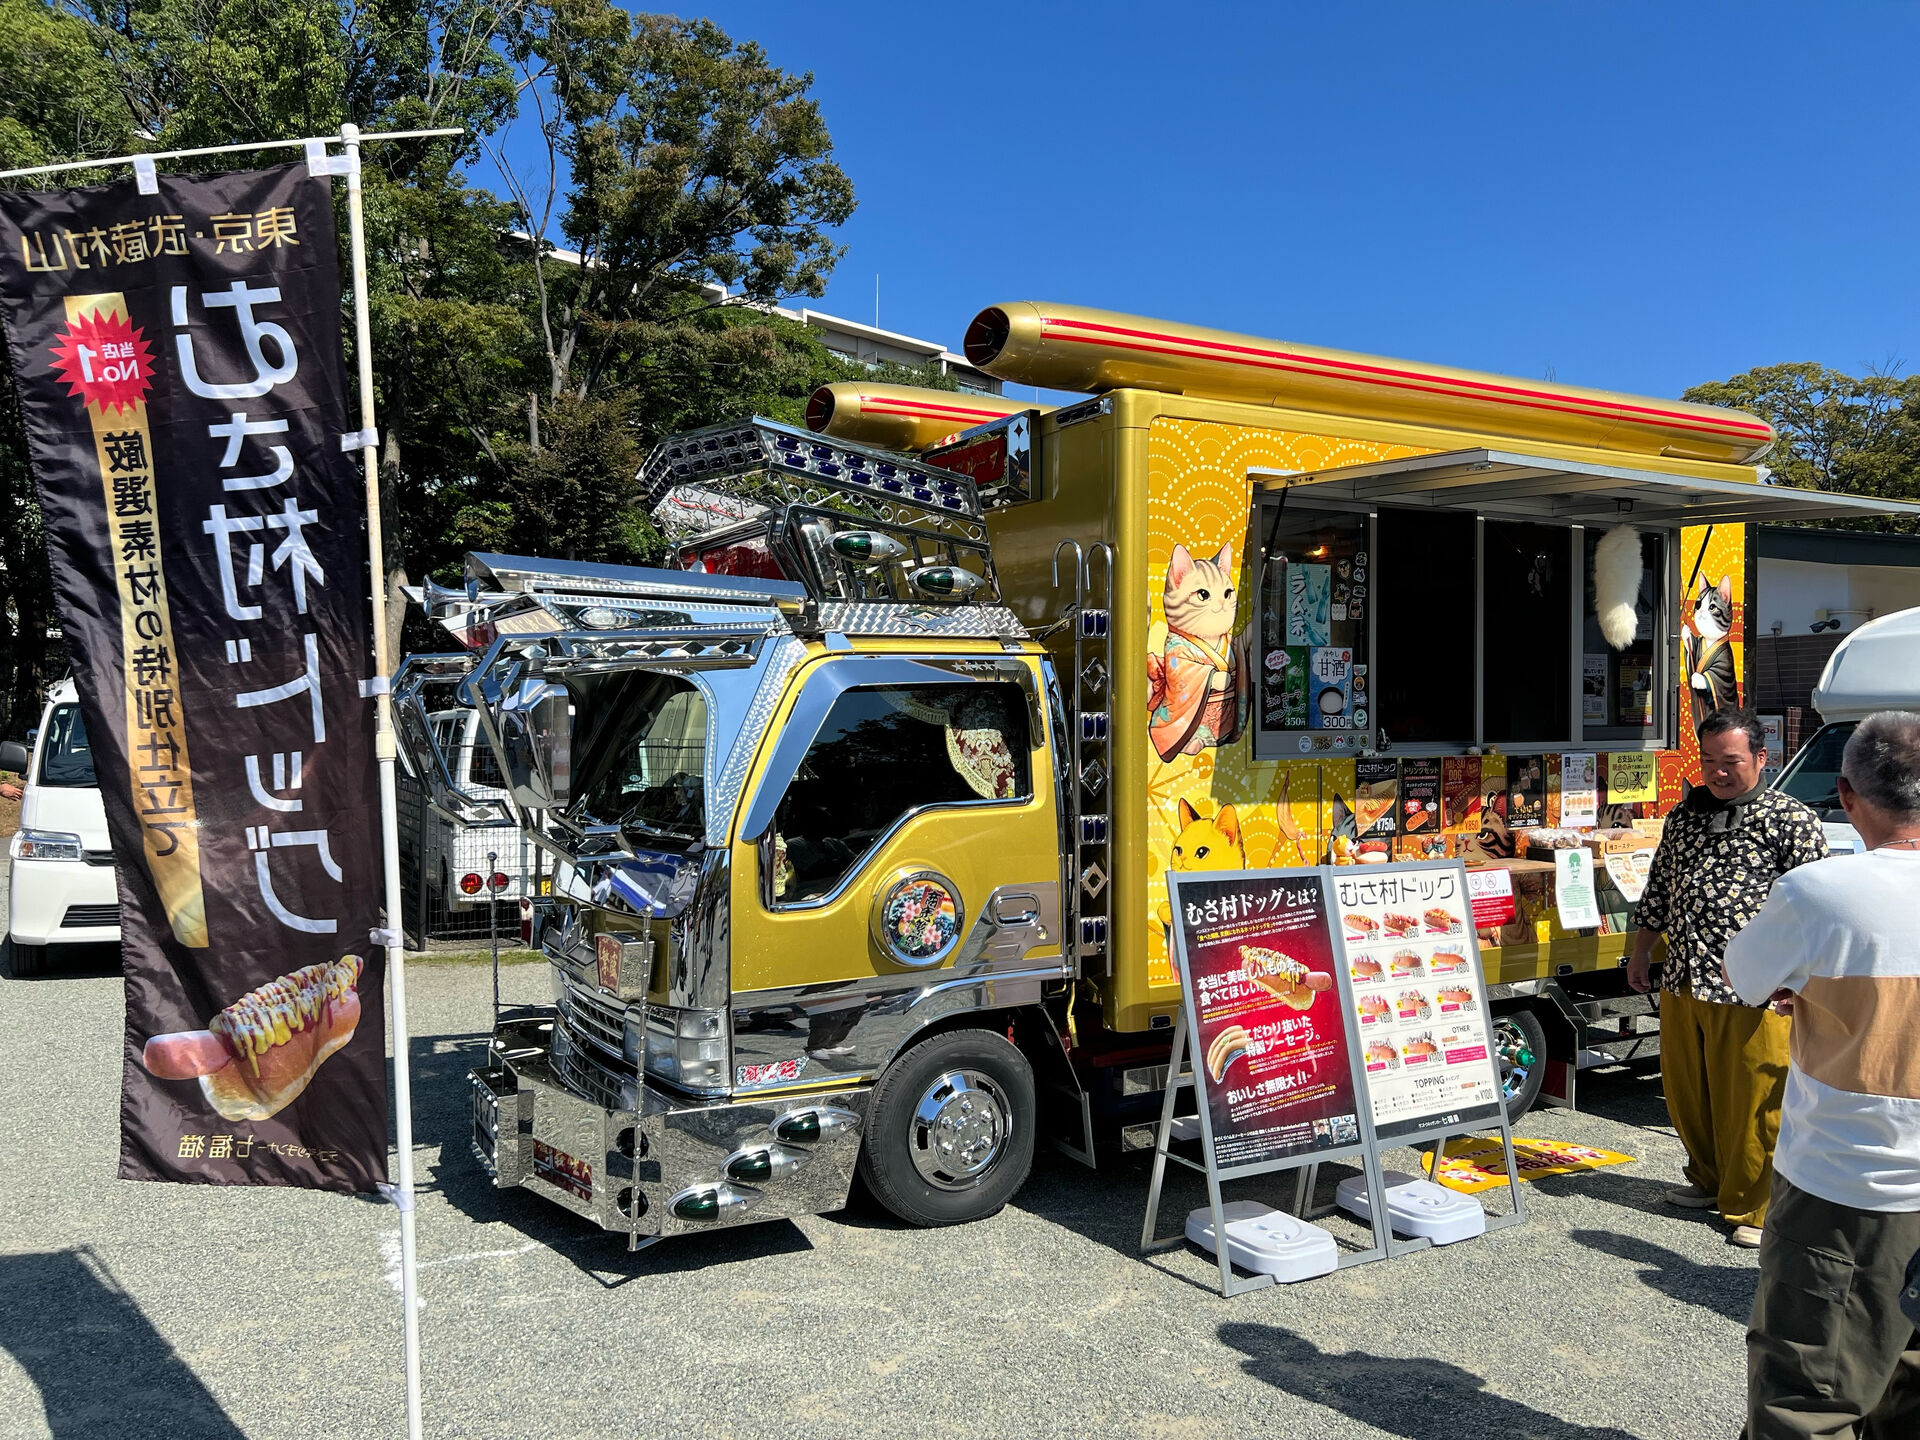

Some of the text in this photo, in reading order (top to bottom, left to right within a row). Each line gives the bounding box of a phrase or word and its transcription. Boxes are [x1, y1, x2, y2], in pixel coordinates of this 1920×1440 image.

[1291, 574, 1307, 637] ラムネ
[1323, 650, 1340, 658] 冷やし
[1318, 658, 1346, 677] 甘酒
[1323, 716, 1352, 728] 300円
[1617, 754, 1643, 763] お支払いは
[1357, 763, 1397, 774] むさ村ドッグ
[1448, 769, 1462, 780] DOG
[1339, 874, 1455, 907] むさ村ドッグ
[1185, 886, 1318, 926] むさ村ドッグとは?
[1200, 981, 1267, 1007] 食べてほしい。
[1244, 1014, 1313, 1042] こだわり抜いた
[1451, 1025, 1471, 1034] OTHER
[1245, 1028, 1321, 1058] 特製ソーセージ。
[1413, 1075, 1446, 1089] TOPPING
[1480, 1088, 1494, 1101] ¥100
